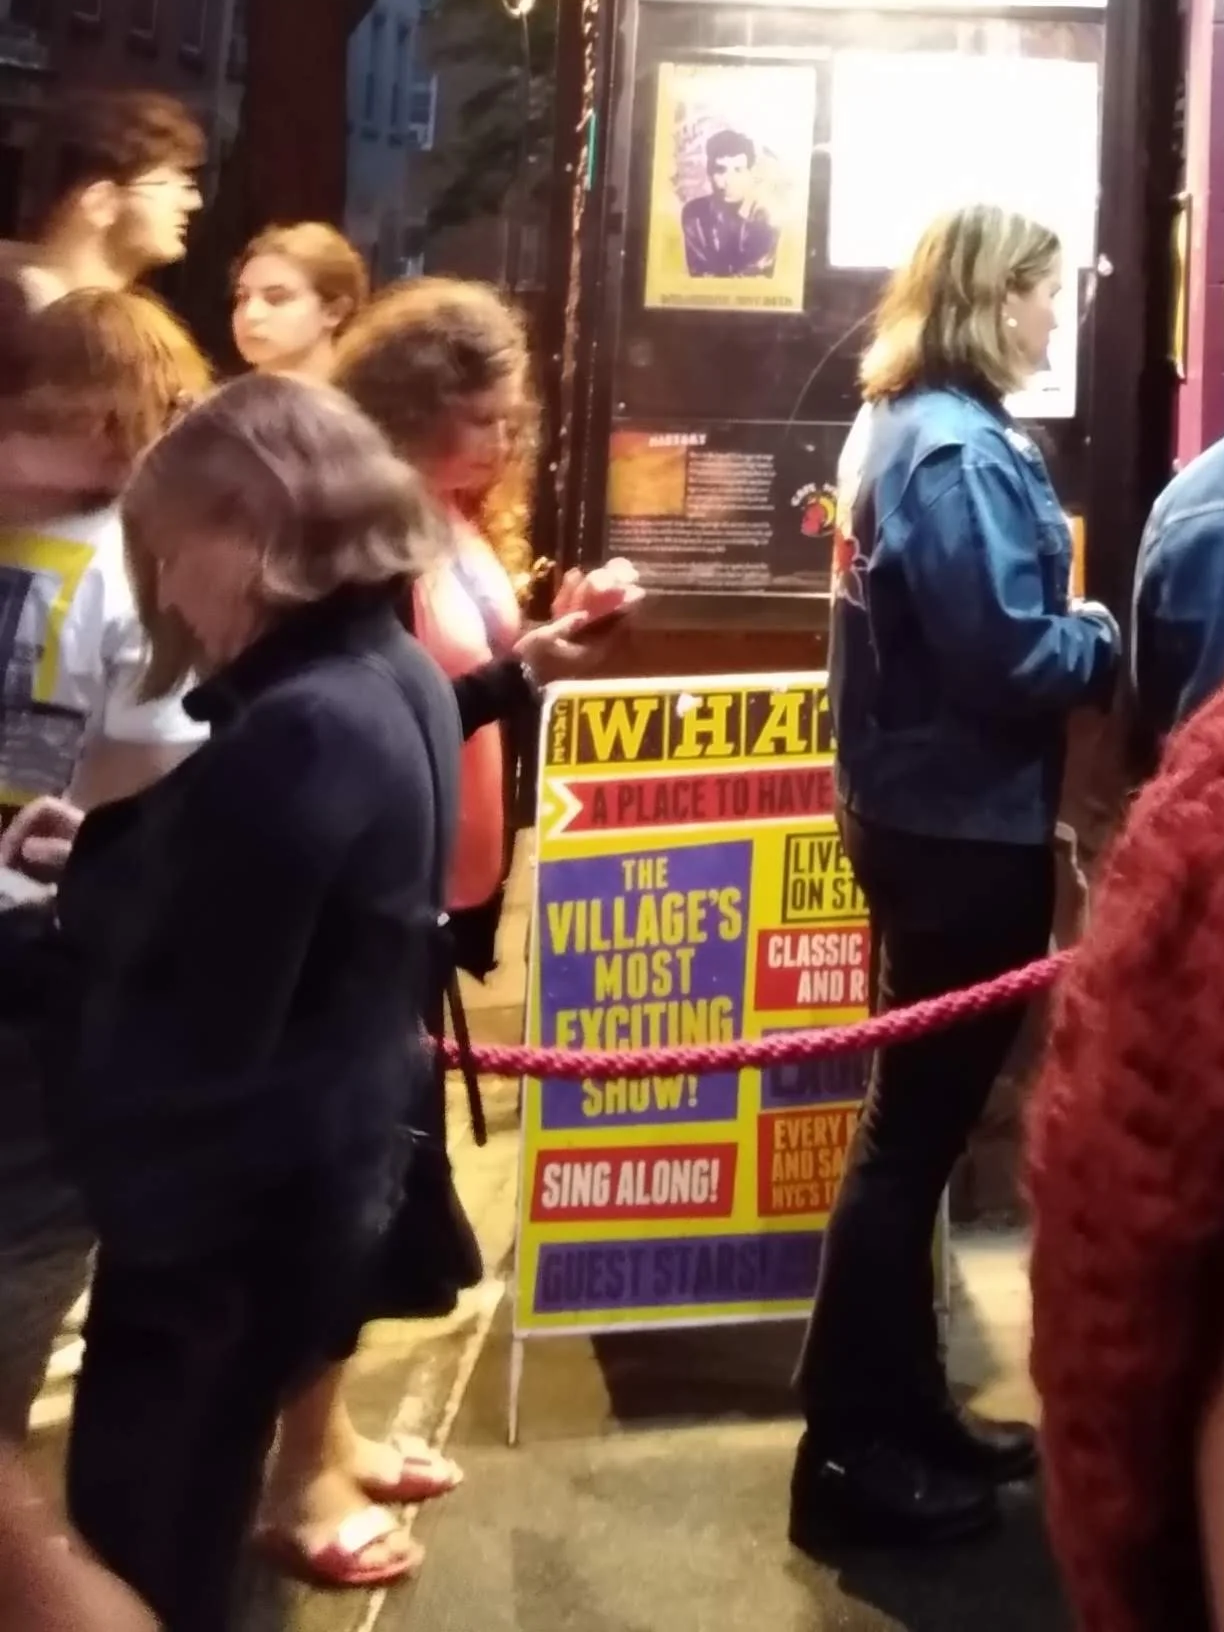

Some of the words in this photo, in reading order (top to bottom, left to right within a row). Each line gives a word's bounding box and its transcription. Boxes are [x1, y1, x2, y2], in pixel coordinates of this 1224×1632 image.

[553, 701, 569, 763] CAFE
[582, 691, 836, 761] WHA
[591, 786, 608, 824] A
[616, 779, 706, 823] PLACE
[716, 775, 749, 815] TO
[758, 770, 833, 813] HAVE
[622, 857, 669, 891] THE
[791, 878, 825, 911] ON
[832, 877, 869, 910] ST
[547, 886, 742, 956] VILLAGE'S
[594, 948, 696, 1003] MOST
[768, 933, 864, 969] CLASSIC
[797, 970, 845, 1004] AND
[556, 995, 734, 1052] EXCITING
[582, 1073, 698, 1118] SHOW!
[774, 1114, 842, 1150] EVERY
[541, 1161, 612, 1209] SING
[616, 1158, 721, 1207] ALONG!
[772, 1150, 814, 1183] AND
[542, 1247, 645, 1302] GUEST
